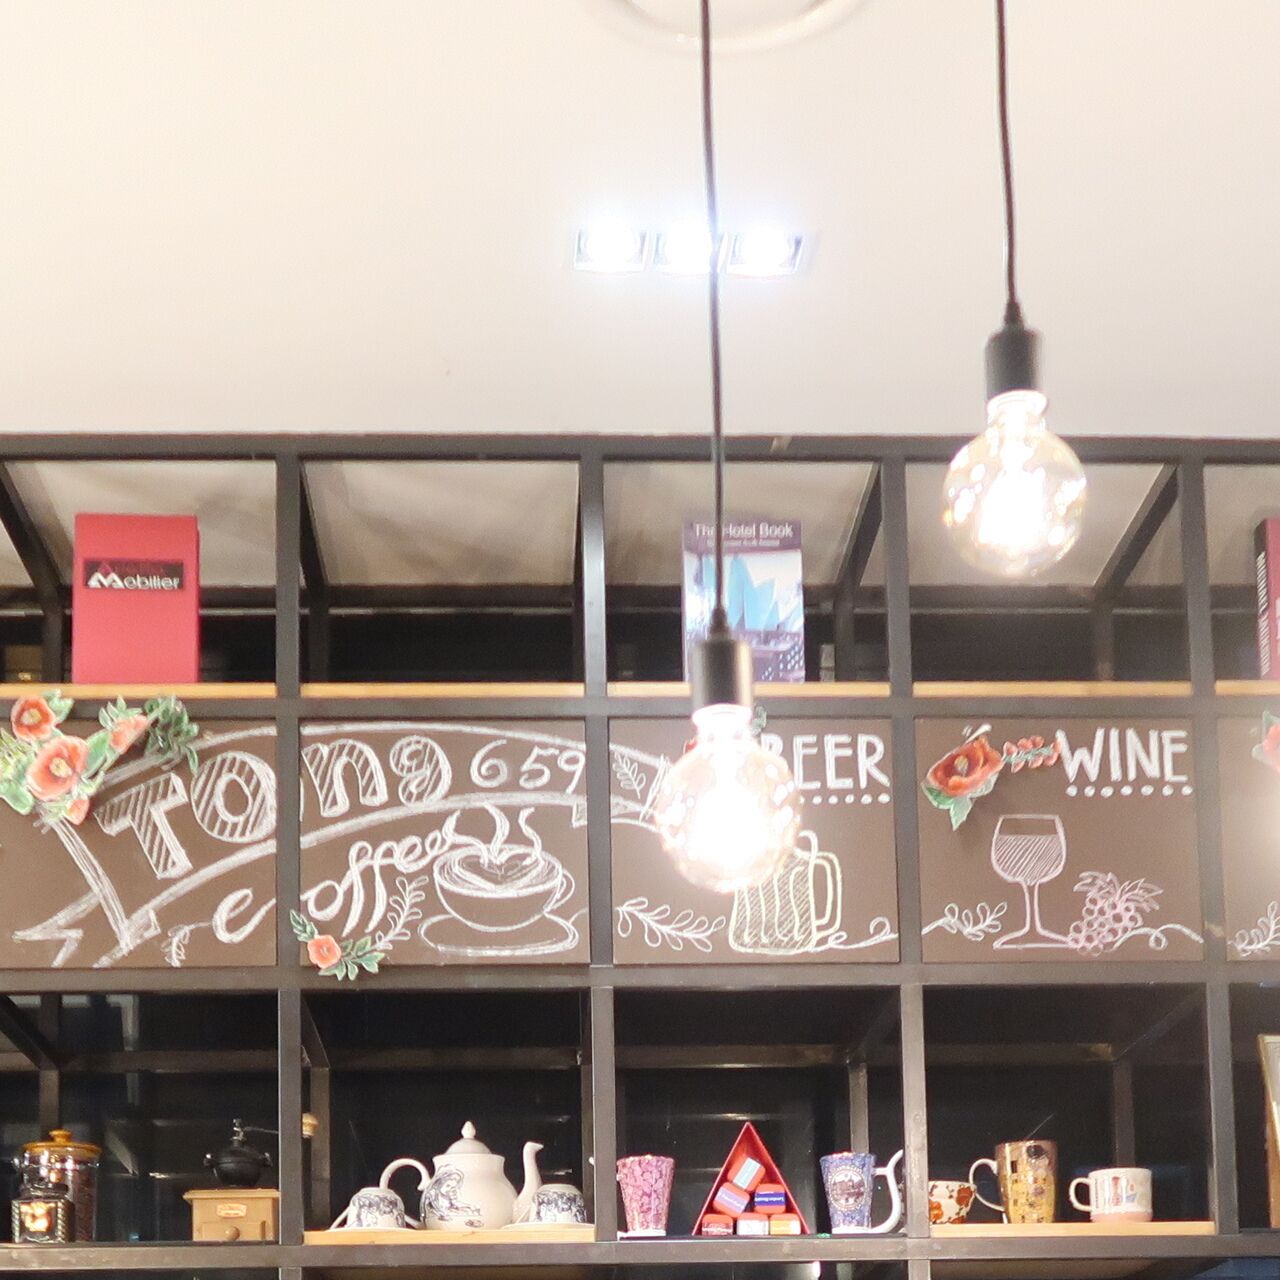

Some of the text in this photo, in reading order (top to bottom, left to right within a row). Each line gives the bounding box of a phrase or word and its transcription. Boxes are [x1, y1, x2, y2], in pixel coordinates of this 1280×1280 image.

[759, 522, 793, 538] Book
[87, 571, 180, 591] Mobilier
[470, 738, 586, 792] 659
[1057, 729, 1190, 783] WINE
